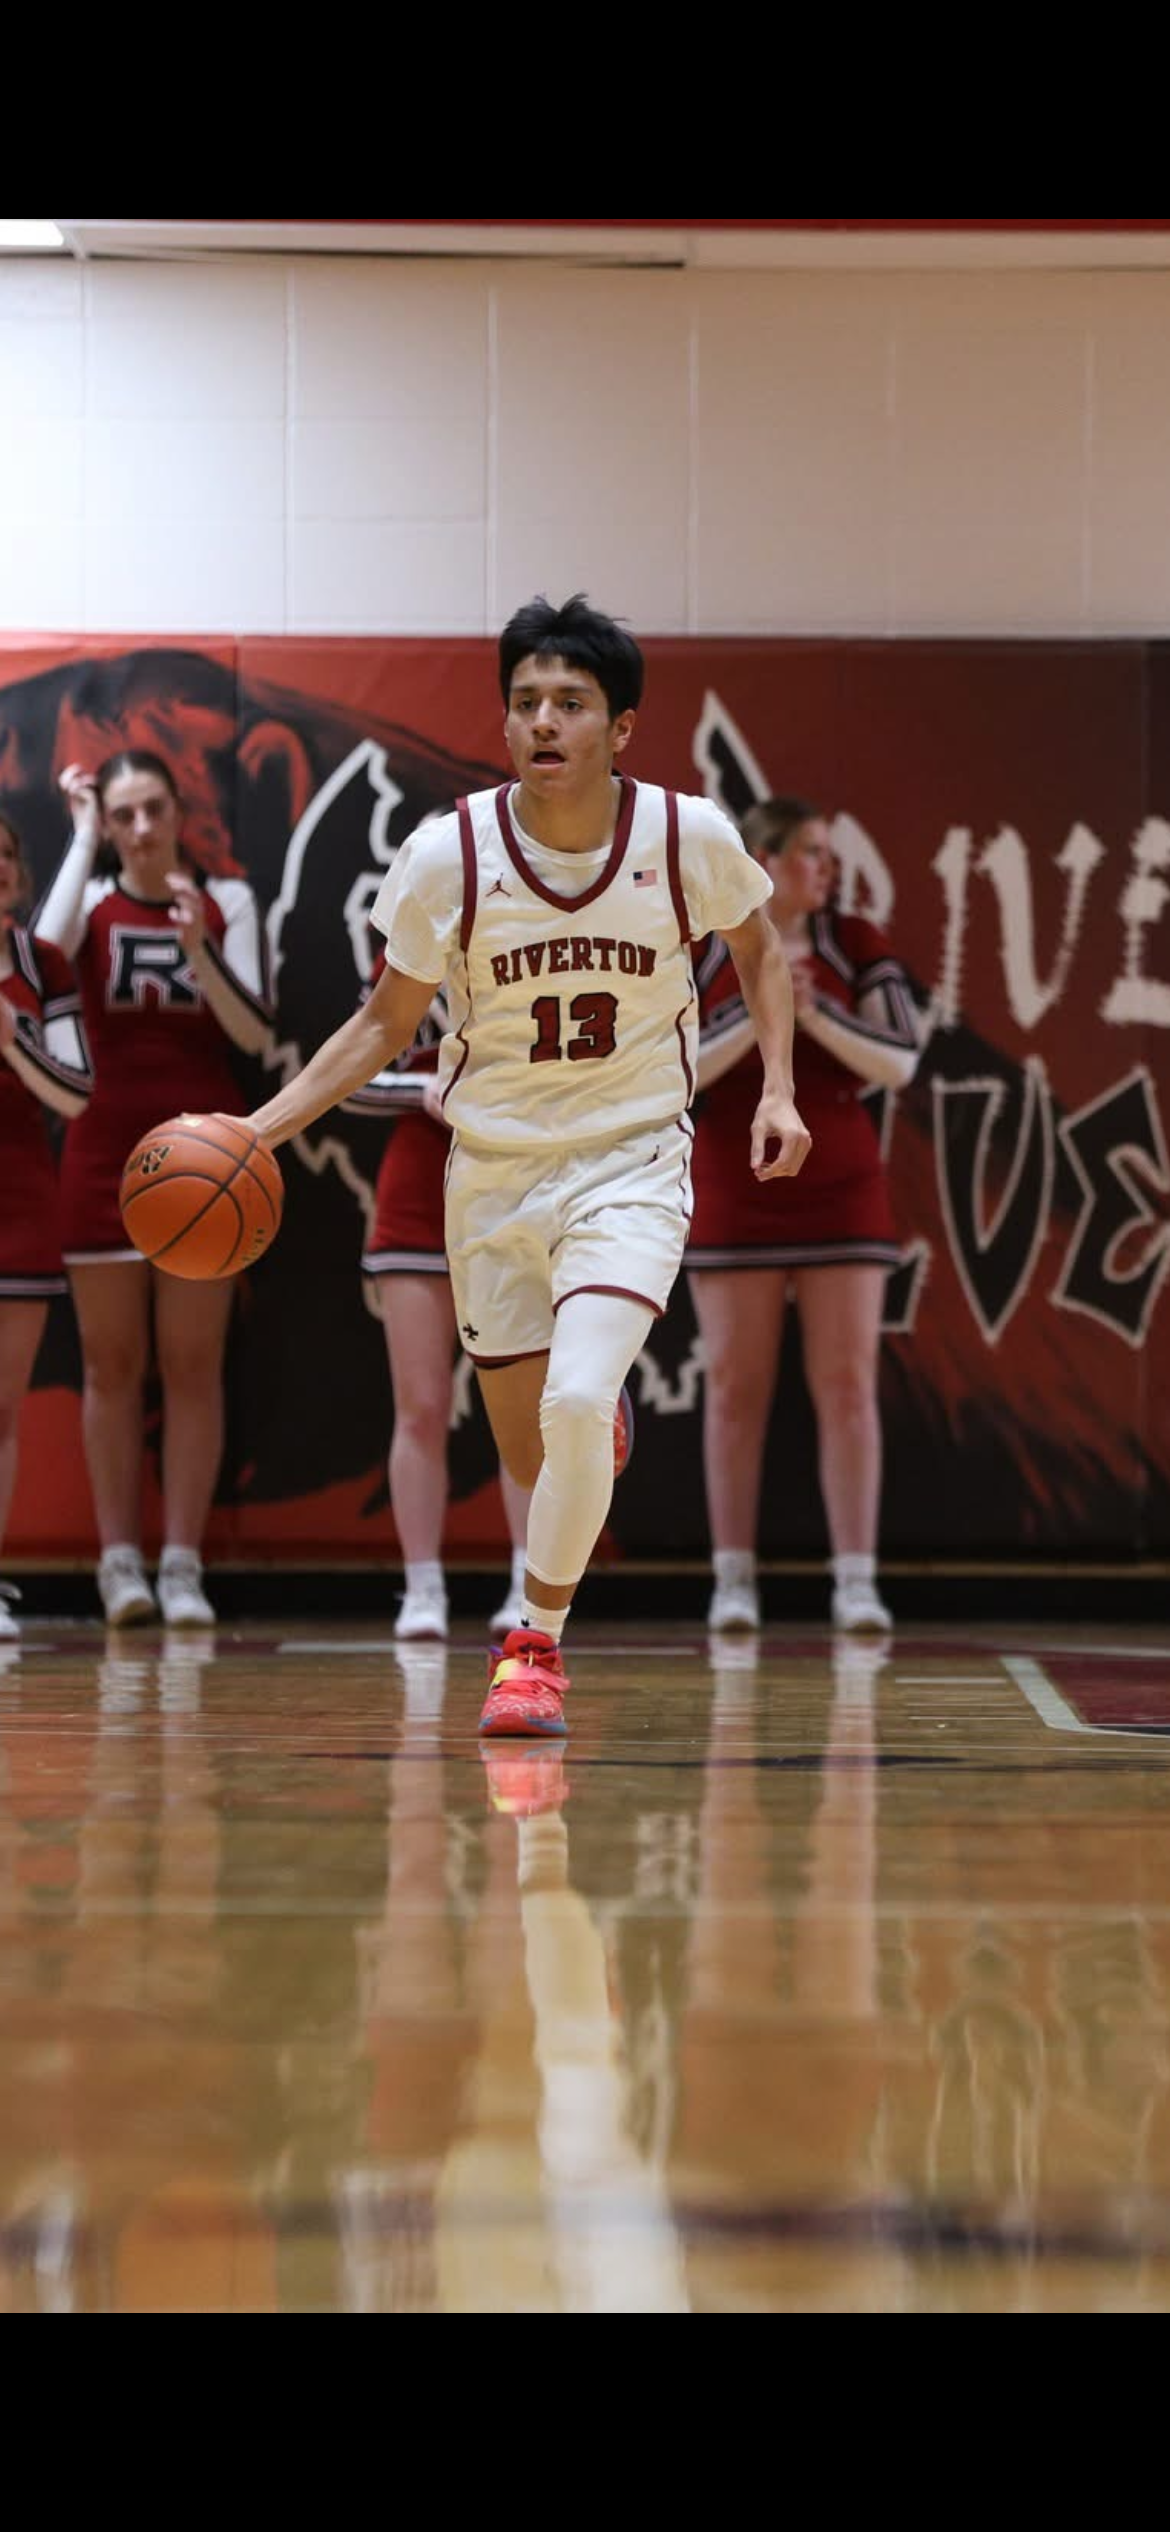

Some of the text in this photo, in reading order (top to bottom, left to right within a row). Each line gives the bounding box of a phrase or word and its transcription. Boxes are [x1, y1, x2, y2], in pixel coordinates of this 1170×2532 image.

[105, 924, 203, 1013] R
[490, 936, 657, 987] RIVERTON
[530, 991, 619, 1063] 13
